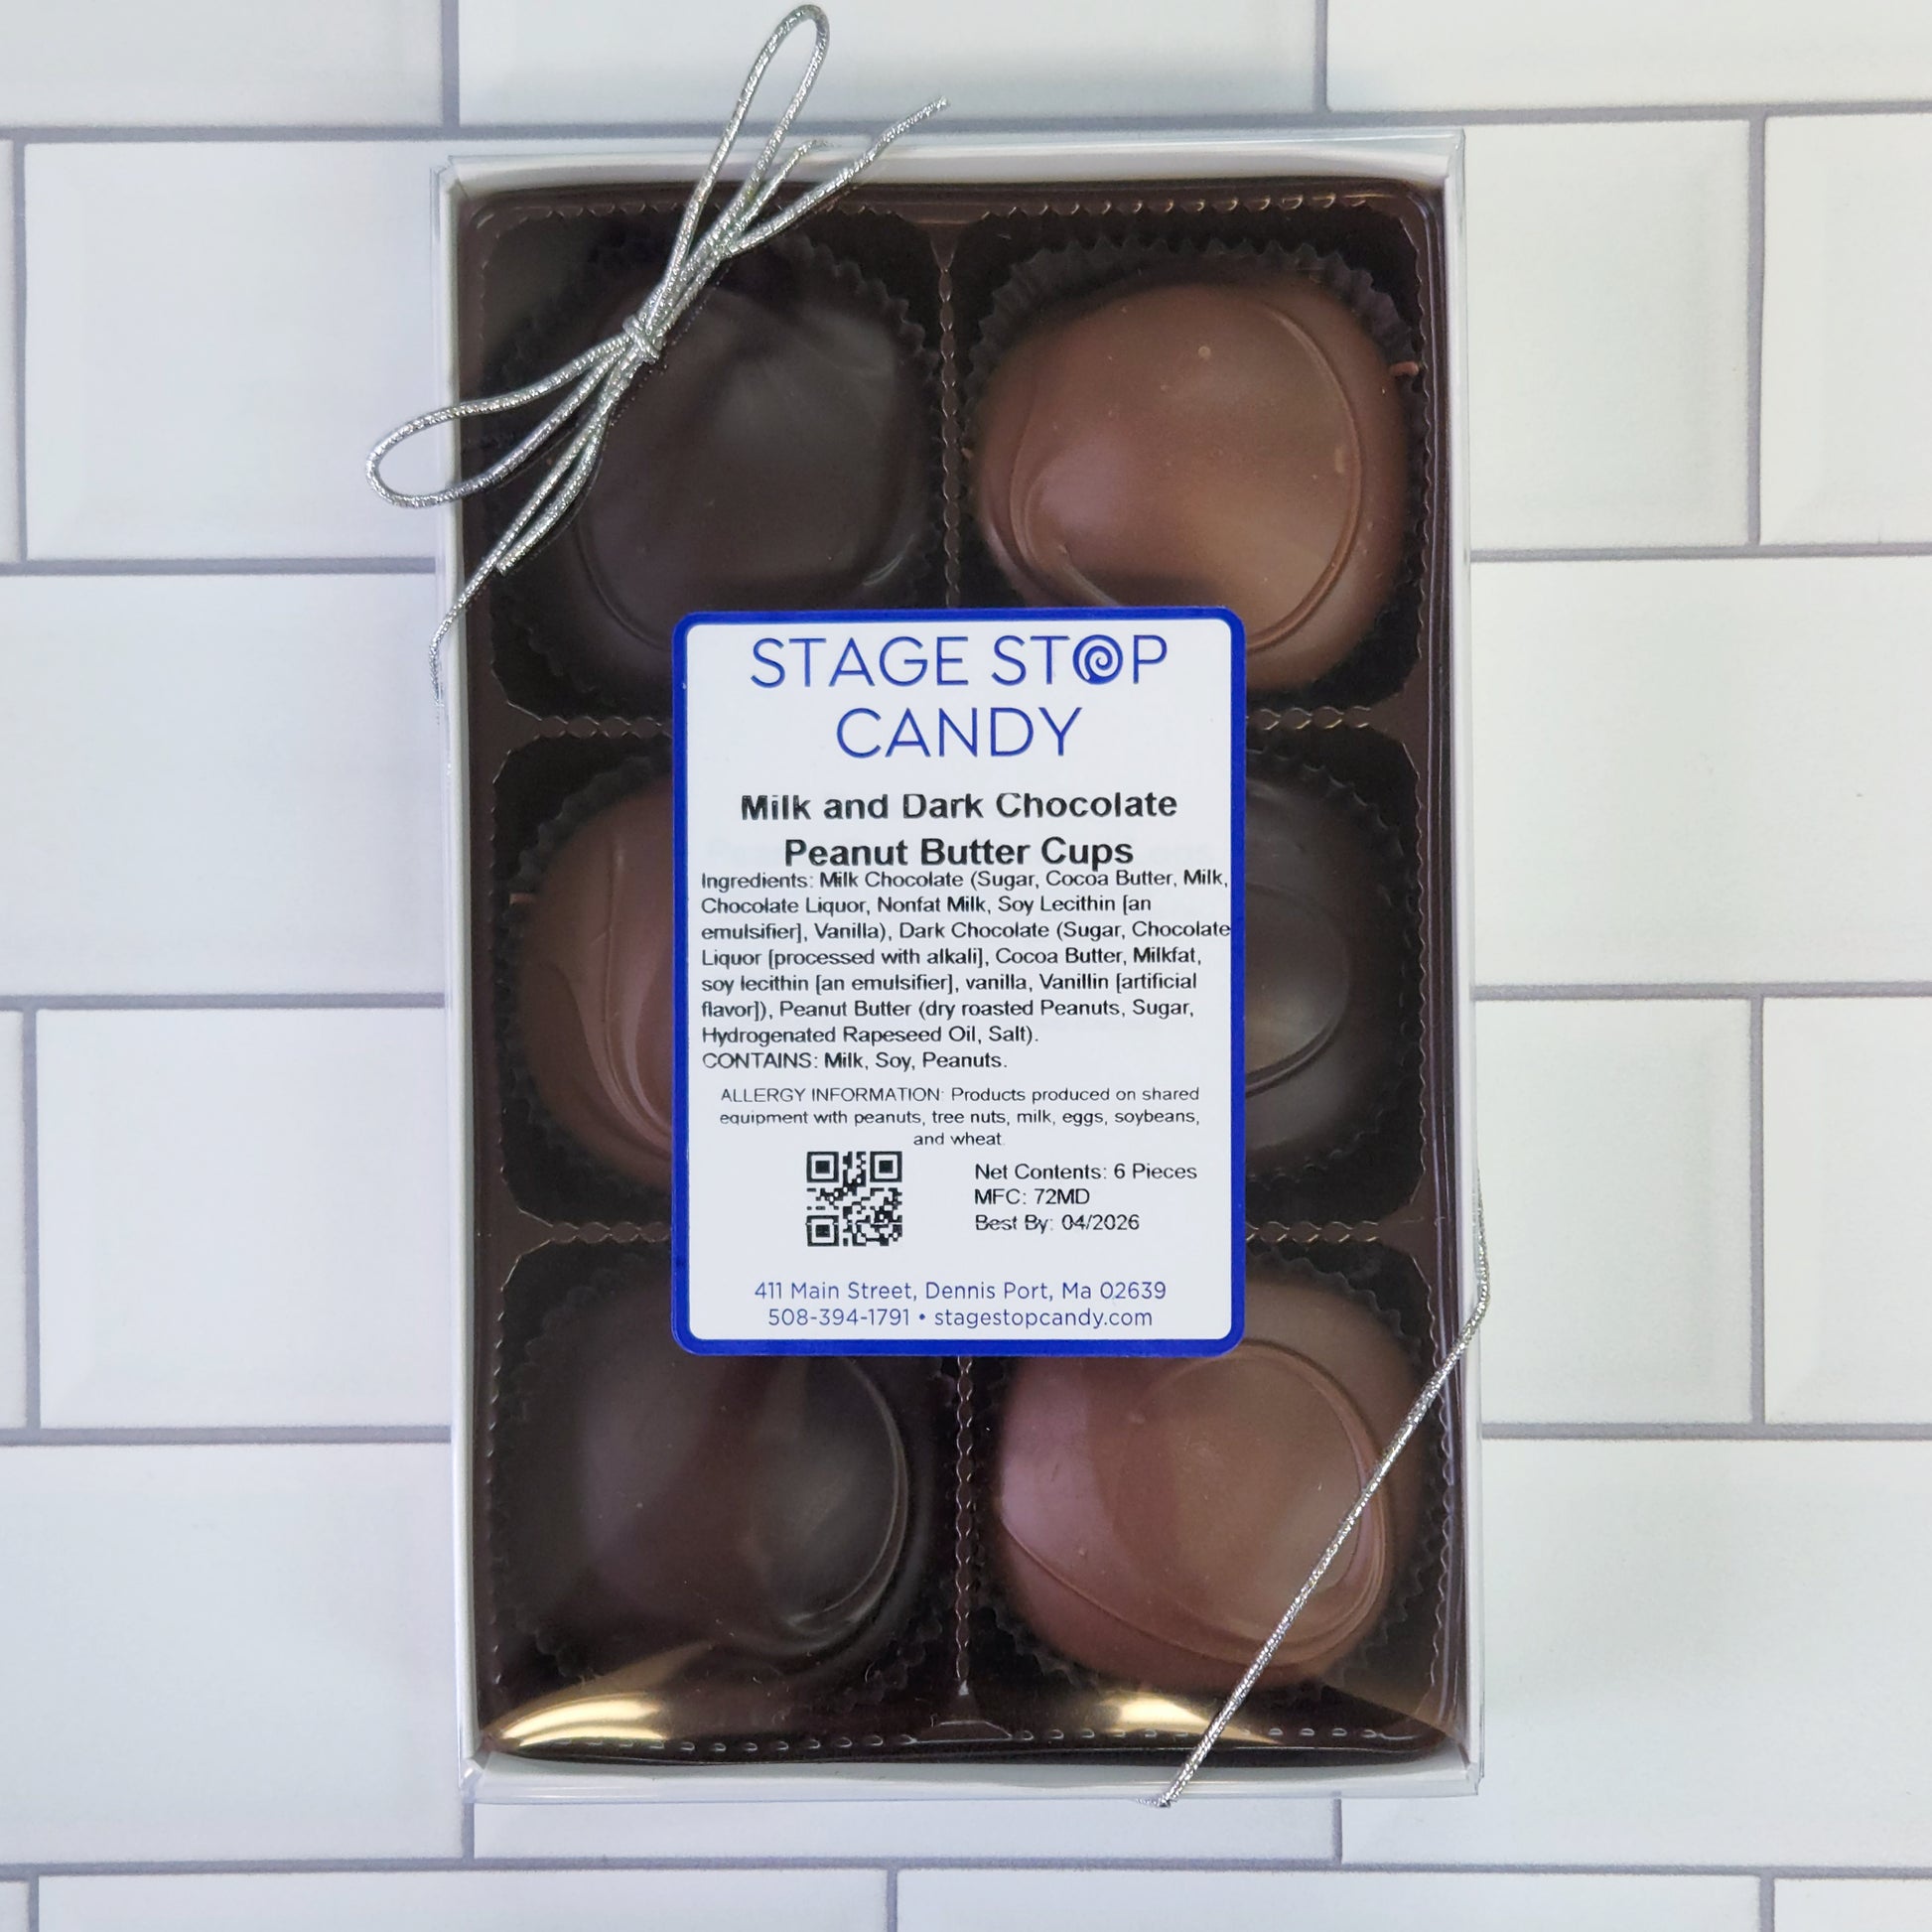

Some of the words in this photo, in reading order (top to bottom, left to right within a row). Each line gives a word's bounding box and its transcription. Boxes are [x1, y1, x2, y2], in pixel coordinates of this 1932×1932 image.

[751, 635, 969, 689] STAGE
[991, 634, 1168, 686] STOP
[836, 707, 1082, 759] CANDY
[741, 794, 811, 821] Milk
[823, 793, 889, 820] and
[902, 793, 984, 819] Dark
[996, 791, 1177, 818] Chocolate
[785, 839, 908, 867] Peanut
[920, 838, 1032, 866] Butter
[1041, 836, 1134, 873] Cups
[702, 872, 813, 894] Ingredients:
[820, 871, 859, 888] Milk
[865, 871, 964, 888] Chocolate
[970, 870, 1039, 892] (Sugar,
[1045, 870, 1109, 887] Cocoa
[1116, 869, 1176, 888] Butter,
[1183, 869, 1227, 888] Milk,
[701, 897, 799, 913] Chocolate
[805, 897, 870, 917] Liquor,
[878, 896, 941, 912] Nonfat
[947, 896, 991, 914] Milk,
[998, 896, 1035, 916] Soy
[1040, 895, 1115, 911] Lecithin
[1123, 895, 1151, 915] [an
[701, 922, 807, 943] emulsifier],
[814, 922, 892, 943] Vanilla),
[899, 922, 945, 938] Dark
[951, 921, 1049, 938] Chocolate
[1056, 921, 1125, 942] (Sugar,
[1132, 920, 1229, 937] Chocolate
[702, 949, 762, 970] Liquor
[768, 948, 875, 970] [processed
[881, 948, 920, 965] with
[926, 947, 989, 969] alkali],
[996, 947, 1058, 964] Cocoa
[1065, 947, 1127, 966] Butter,
[1133, 946, 1201, 966] Milkfat,
[701, 979, 735, 996] soy
[741, 974, 809, 991] lecithin
[815, 974, 845, 996] [an
[851, 974, 959, 995] emulsifier],
[965, 973, 1033, 993] vanilla,
[1038, 973, 1109, 990] Vanillin
[1116, 972, 1196, 994] [artificial
[701, 1001, 772, 1022] flavor]),
[779, 1001, 847, 1017] Peanut
[854, 1000, 912, 1017] Butter
[918, 1000, 956, 1021] (dry
[962, 1000, 1034, 1017] roasted
[1040, 999, 1125, 1018] Peanuts,
[1133, 999, 1193, 1020] Sugar,
[702, 1026, 836, 1047] Hydrogenated
[843, 1026, 942, 1046] Rapeseed
[948, 1026, 982, 1044] Oil,
[989, 1026, 1038, 1046] Salt).
[702, 1052, 818, 1069] CONTAINS:
[824, 1051, 869, 1070] Milk,
[875, 1051, 915, 1072] Soy,
[922, 1051, 1007, 1068] Peanuts.
[721, 1088, 806, 1102] ALLERGY
[951, 1087, 1026, 1101] Products
[1032, 1088, 1110, 1105] produced
[1116, 1090, 1136, 1101] on
[1142, 1087, 1199, 1101] shared
[720, 1111, 808, 1126] equipment
[813, 1110, 848, 1124] with
[854, 1111, 925, 1127] peanuts,
[931, 1110, 965, 1124] tree
[970, 1110, 1010, 1126] nuts,
[1017, 1109, 1055, 1126] milk,
[1062, 1113, 1107, 1127] eggs,
[1115, 1109, 1199, 1126] soybeans,
[913, 1132, 944, 1146] and
[975, 1164, 1008, 1179] Net
[1015, 1164, 1107, 1179] Contents:
[1114, 1163, 1126, 1179] 6
[1133, 1163, 1197, 1179] Pieces
[974, 1188, 1027, 1205] MFC:
[1034, 1188, 1090, 1204] 72MD
[975, 1214, 1018, 1231] Best
[1025, 1214, 1052, 1234] By:
[1061, 1214, 1140, 1230] 04/2026
[755, 1282, 781, 1299] 411
[791, 1282, 839, 1300] Main
[848, 1281, 916, 1302] Street,
[926, 1282, 996, 1300] Dennis
[1004, 1282, 1053, 1302] Port,
[1062, 1282, 1091, 1300] Ma
[1100, 1281, 1166, 1300] 02639
[768, 1309, 908, 1325] 508-394-1791
[934, 1308, 1152, 1329] stagestopcandy.com
